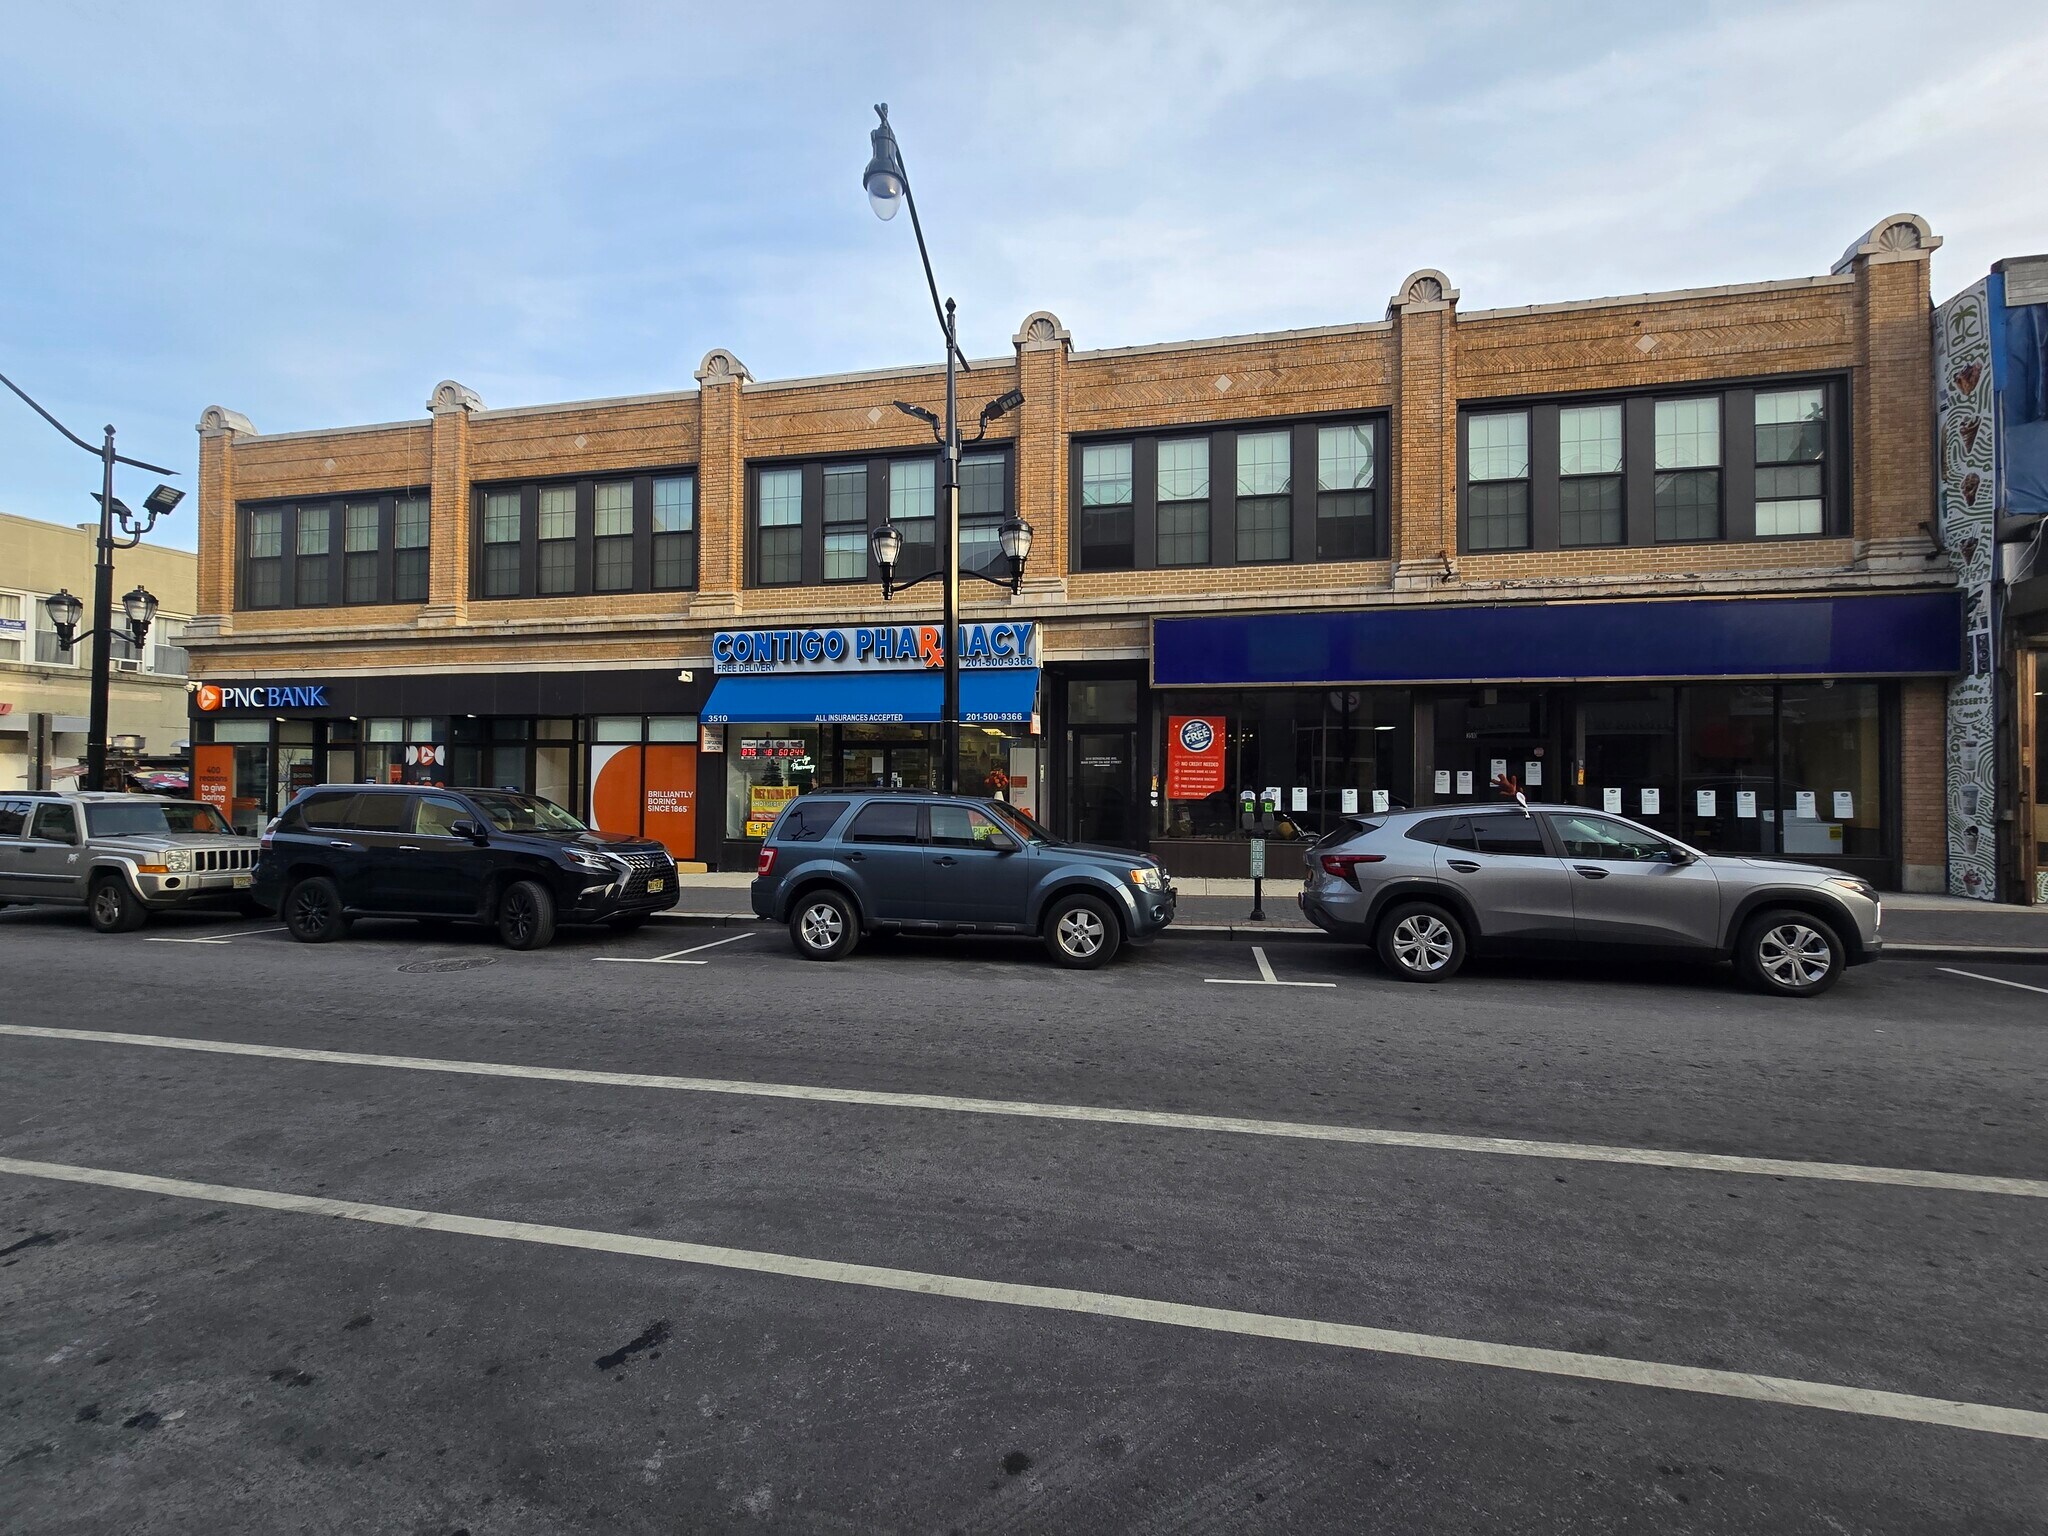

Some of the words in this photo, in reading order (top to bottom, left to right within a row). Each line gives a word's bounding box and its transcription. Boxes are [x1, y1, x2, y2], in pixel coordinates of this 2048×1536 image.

[713, 630, 845, 663] CONTIGO
[965, 656, 1033, 667] 201-500-9366
[717, 664, 737, 673] FREE
[738, 663, 777, 672] DELIVERY
[1955, 684, 1984, 696] DRINKS
[1950, 696, 1989, 706] DESSERTS
[708, 714, 728, 722] 3510
[814, 714, 828, 722] ALL
[828, 713, 868, 722] INSURANCES
[869, 713, 903, 721] ACCEPTED
[965, 713, 1023, 721] 201-500-9366
[1962, 709, 1983, 718] MORE
[1185, 728, 1210, 744] FREE
[206, 766, 220, 774] 400
[199, 774, 228, 782] reasons
[201, 784, 210, 792] to
[210, 784, 226, 793] give
[201, 793, 226, 803] boring
[647, 790, 694, 798] BRILLIANTLY
[647, 797, 677, 805] BORING
[647, 804, 670, 812] SINCE
[671, 805, 688, 813] 1865
